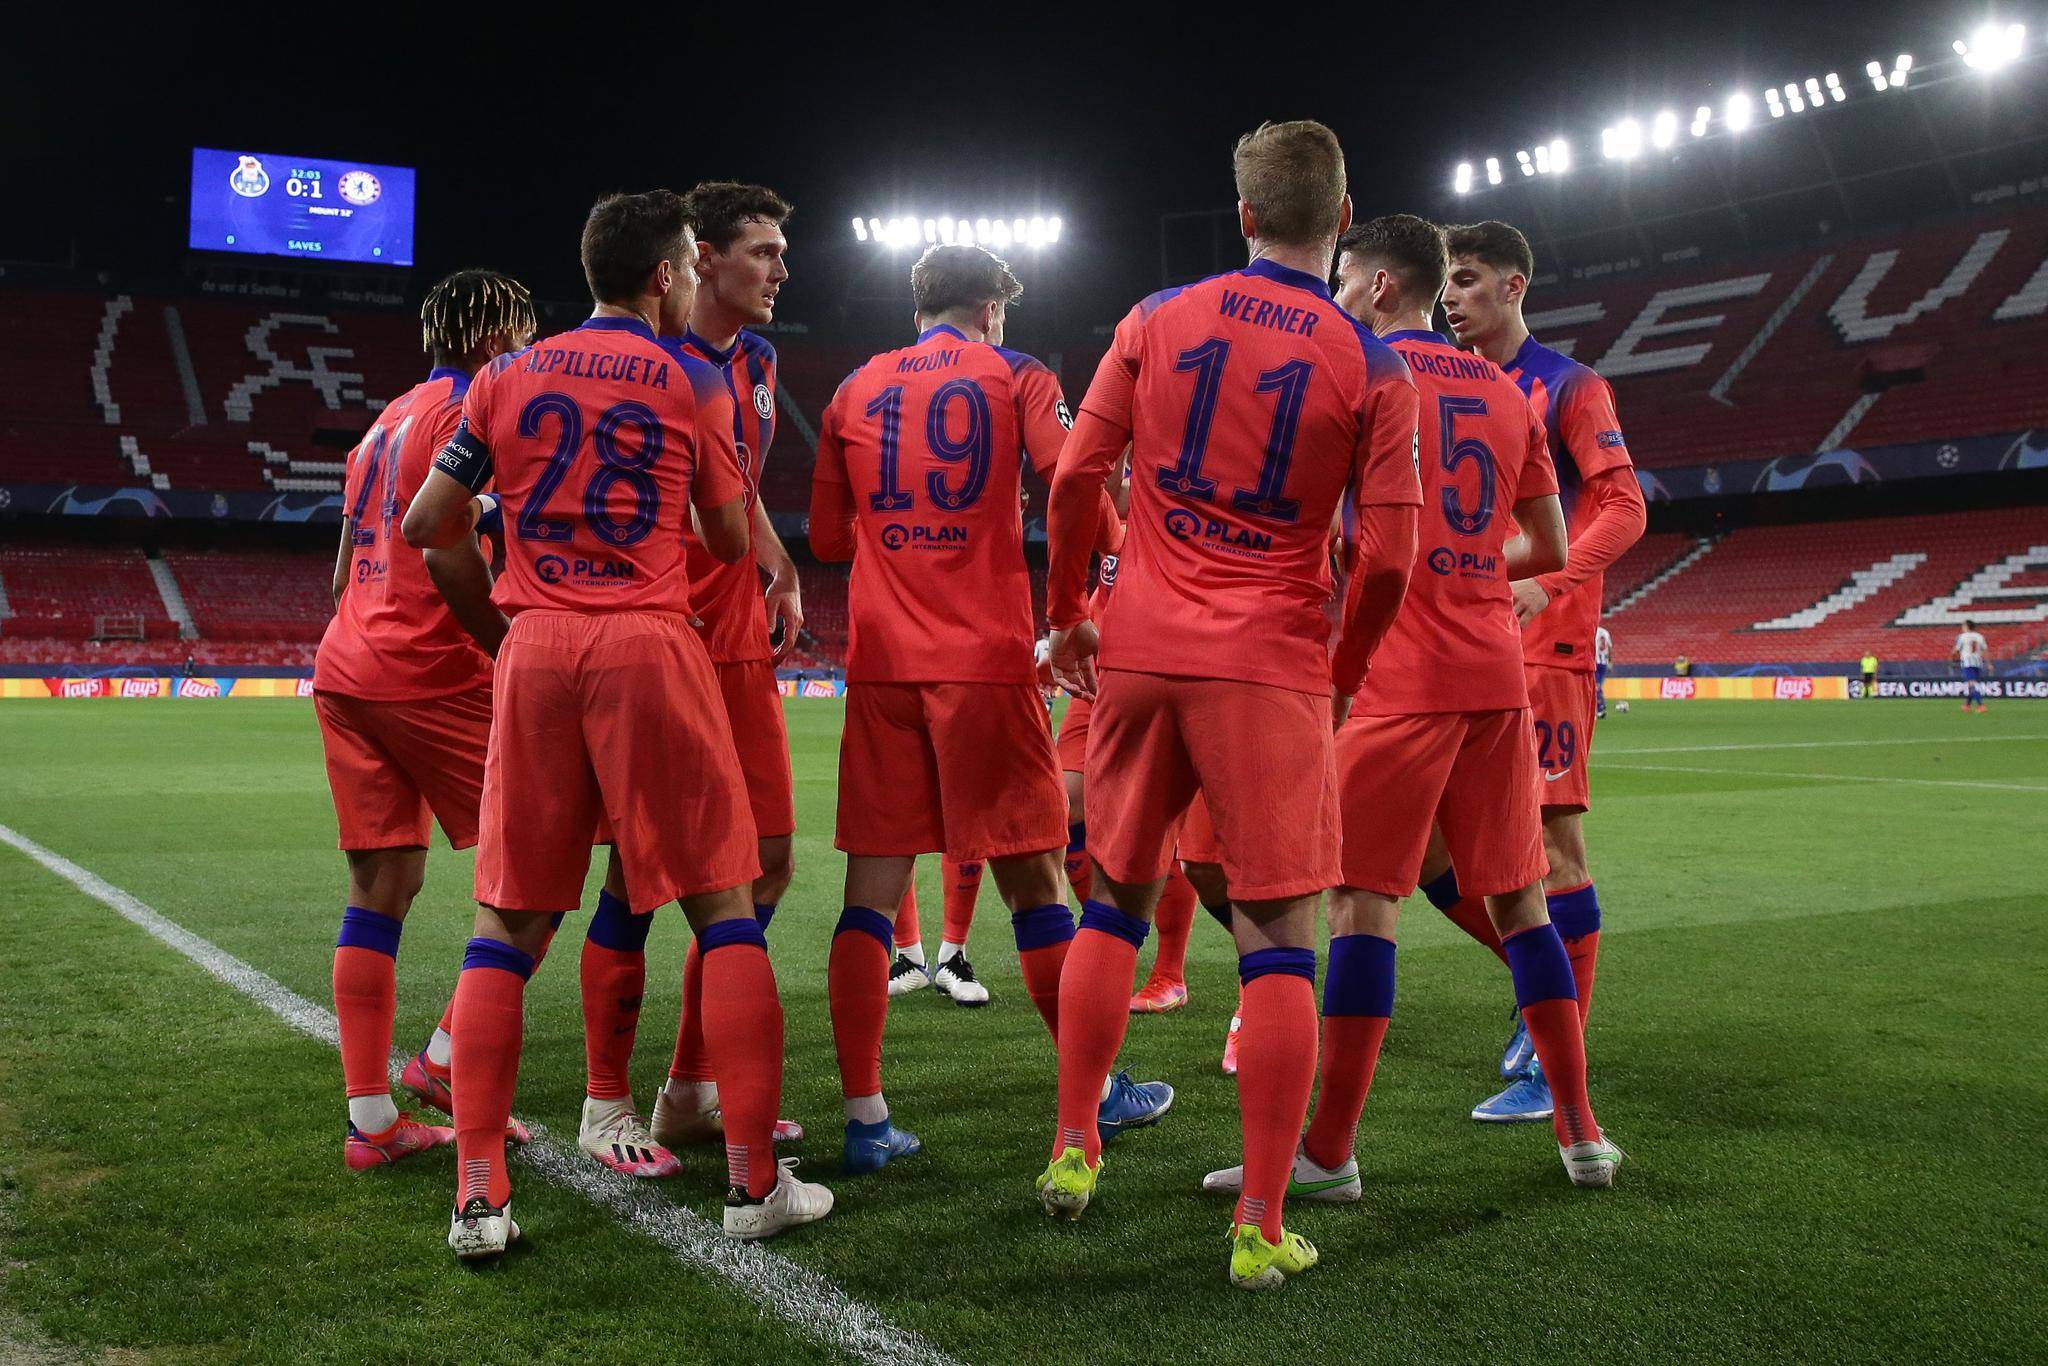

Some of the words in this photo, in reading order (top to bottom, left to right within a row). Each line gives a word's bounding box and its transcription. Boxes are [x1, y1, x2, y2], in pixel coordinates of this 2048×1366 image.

[286, 178, 323, 199] 0:1
[288, 240, 322, 252] SAVES
[1219, 289, 1320, 338] WERNER
[524, 349, 669, 390] AZPILICUETA
[896, 348, 964, 374] MOUNT
[1154, 335, 1317, 524] 11
[446, 440, 473, 459] RACISM
[865, 376, 992, 512] 19
[437, 451, 460, 468] SPECT
[518, 390, 665, 548] 28
[1437, 393, 1496, 536] 5
[912, 526, 968, 542] PLAN
[1204, 519, 1273, 552] PLAN
[1202, 540, 1267, 560] INTERNATIONAL
[573, 559, 635, 578] PLAN
[1460, 553, 1496, 572] PLAN
[1877, 681, 1908, 697] EFA
[1908, 681, 2003, 698] CHAMPINS
[2005, 681, 2048, 698] LEAG
[1535, 720, 1575, 768] 29
